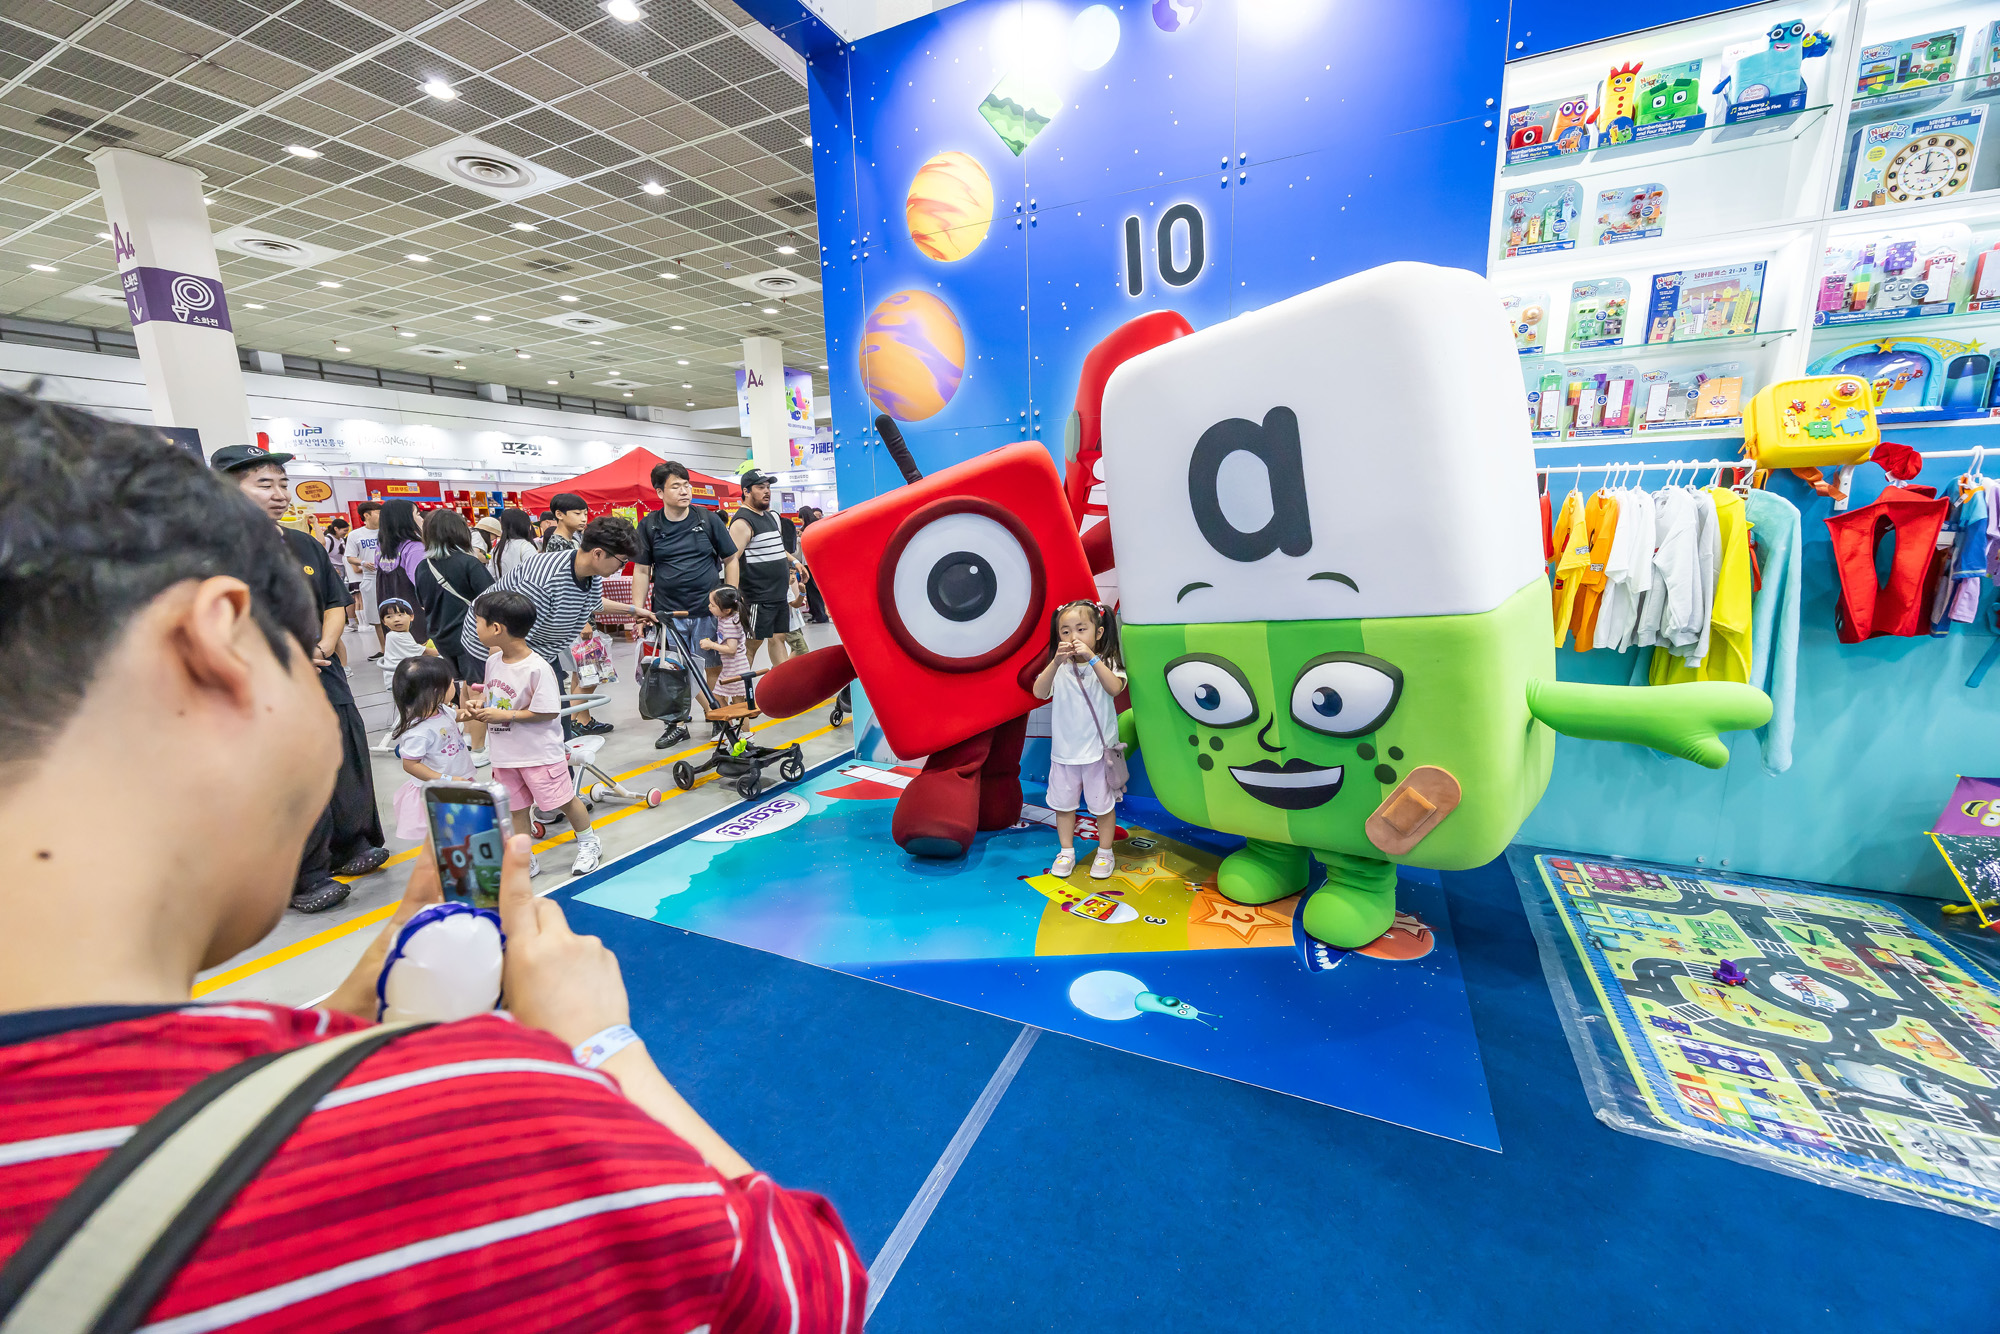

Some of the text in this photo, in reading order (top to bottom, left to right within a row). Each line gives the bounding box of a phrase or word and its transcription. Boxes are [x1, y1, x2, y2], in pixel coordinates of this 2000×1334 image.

[1737, 106, 1771, 116] Numberblock
[1738, 102, 1765, 112] Sing-Along
[1636, 122, 1672, 133] Numberblocks
[1658, 125, 1676, 134] Playful
[1870, 123, 1909, 137] Number
[1511, 146, 1542, 156] Numberblocks
[114, 222, 135, 263] A4
[1124, 203, 1205, 296] 10
[1728, 266, 1748, 274] 21-30
[123, 272, 139, 288] 소화전
[193, 315, 219, 327] 소화전
[747, 369, 764, 389] A4
[1188, 405, 1313, 562] a
[360, 537, 380, 549] BOST
[716, 799, 801, 837] Start!
[1130, 836, 1157, 850] 10
[1120, 863, 1156, 876] 3
[1144, 915, 1167, 926] 3
[1220, 909, 1256, 924] 2
